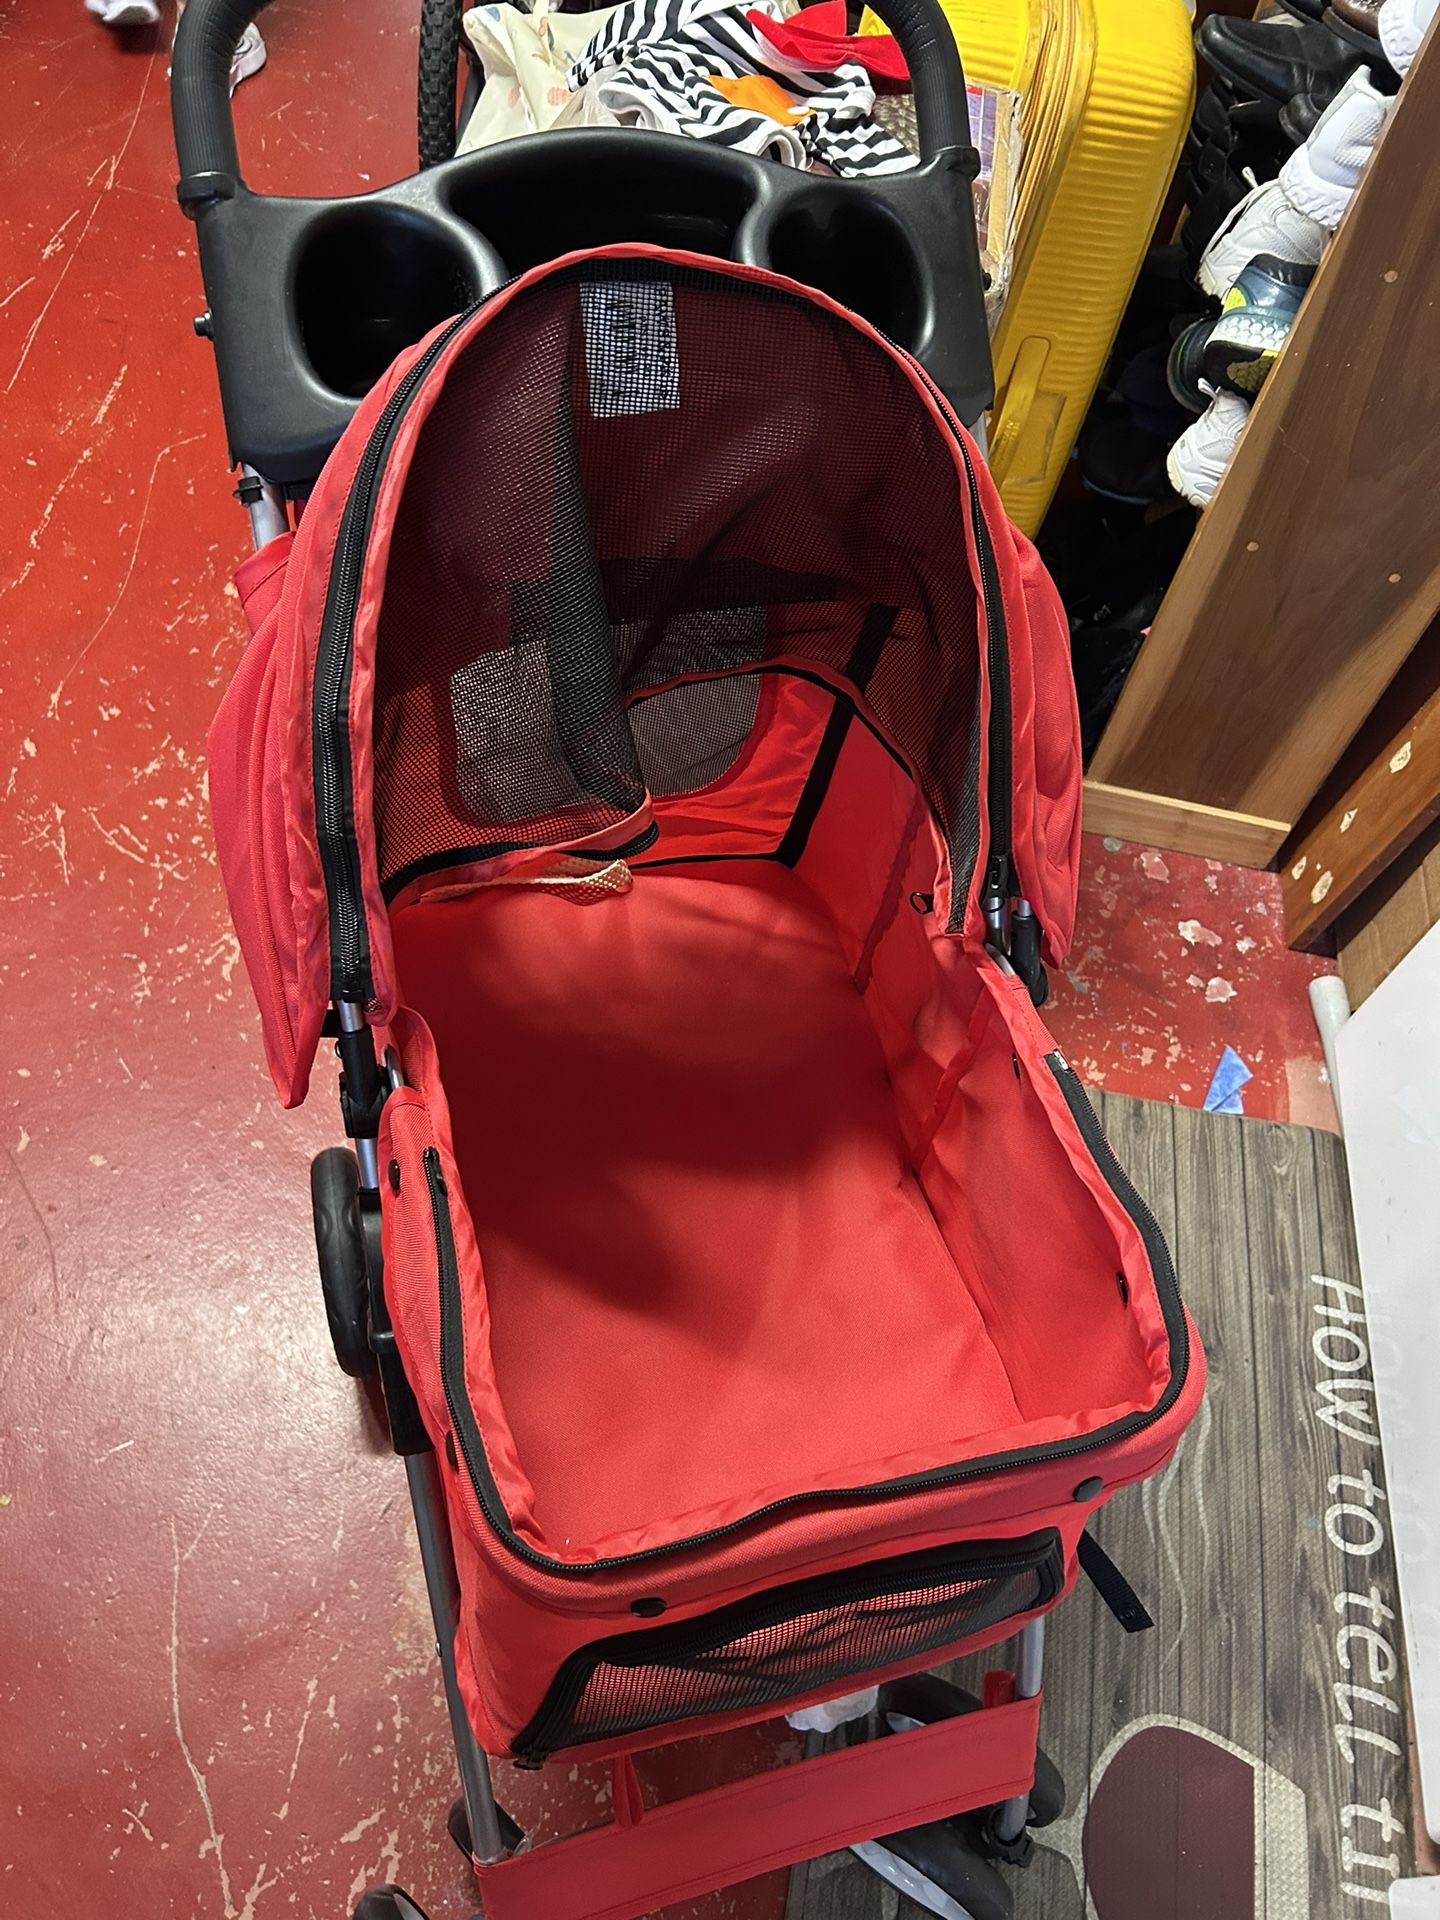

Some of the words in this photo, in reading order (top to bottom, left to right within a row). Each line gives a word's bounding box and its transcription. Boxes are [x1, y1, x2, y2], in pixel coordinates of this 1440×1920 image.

[1311, 1274, 1380, 1446] How
[1324, 1469, 1386, 1557] to
[1334, 1587, 1402, 1764] tell
